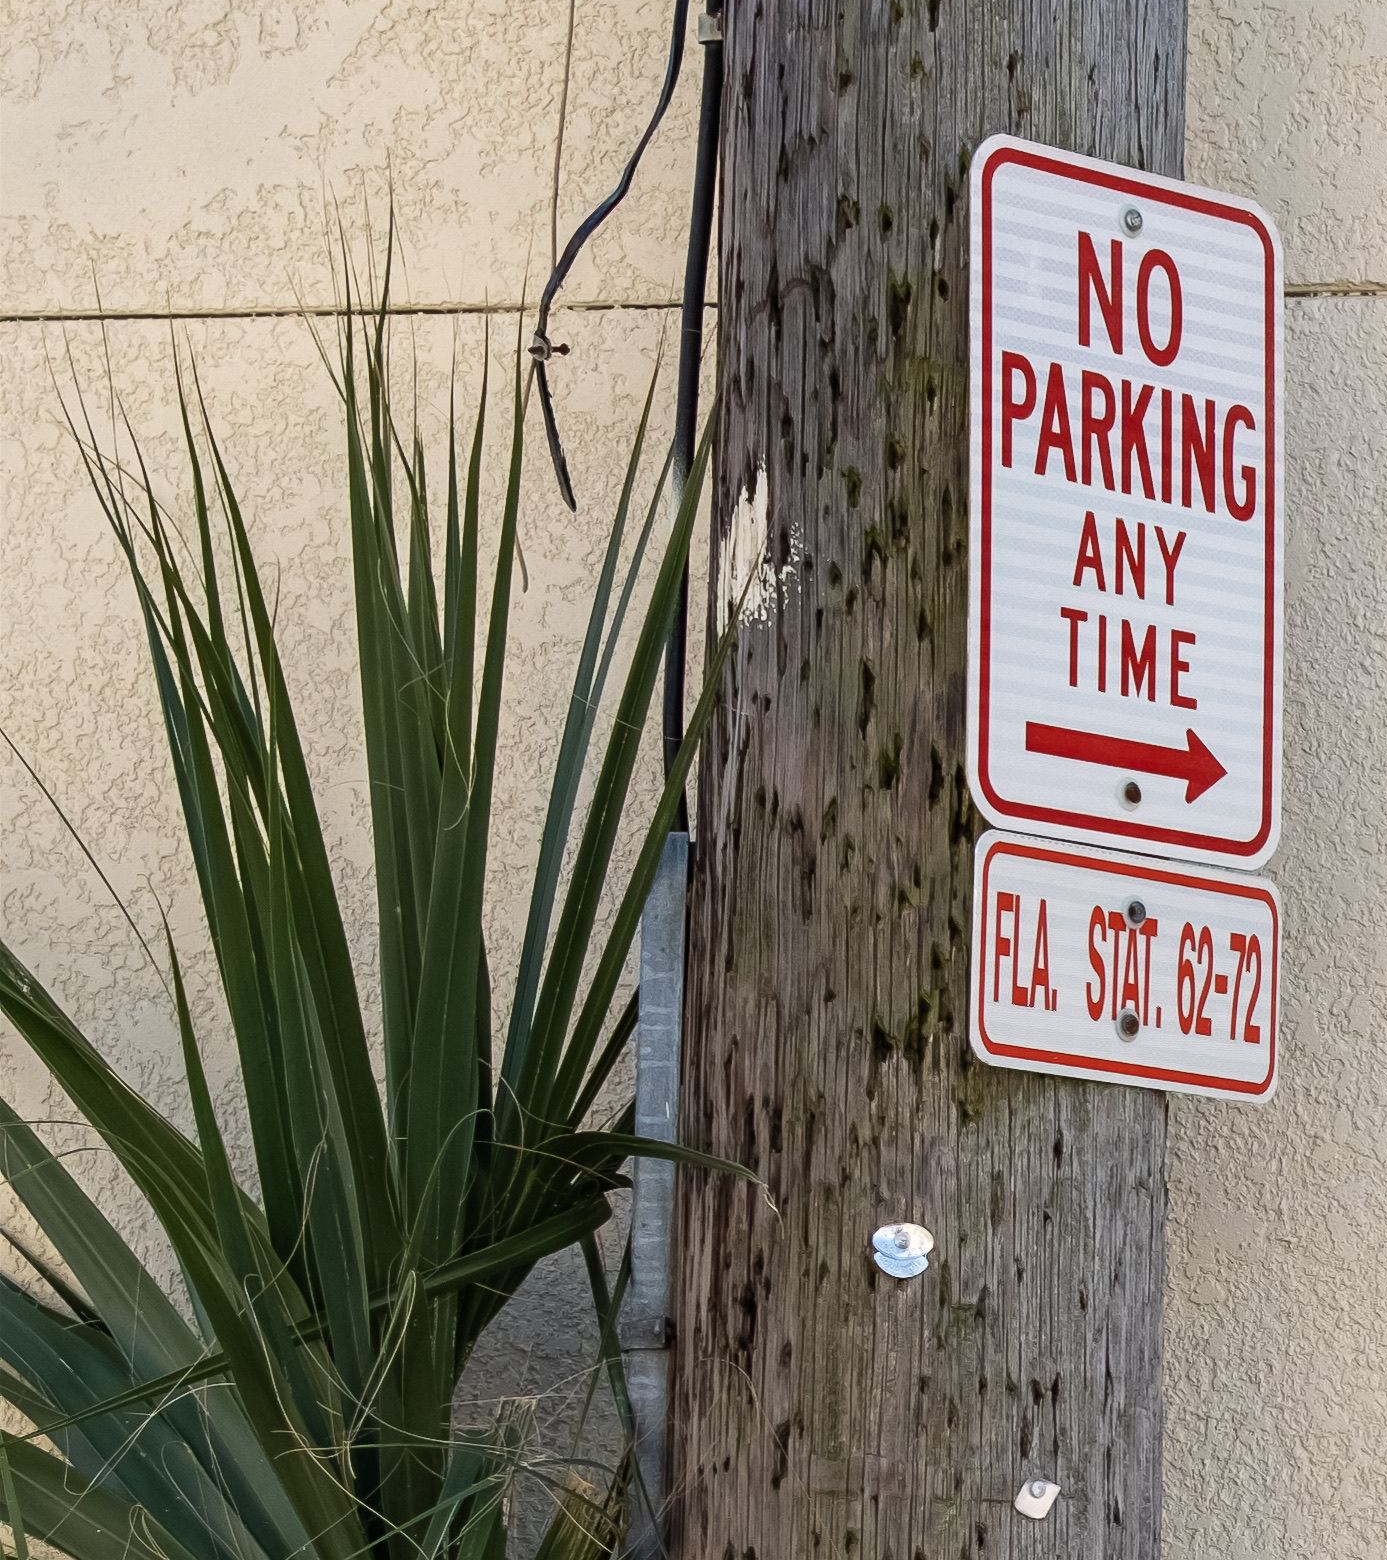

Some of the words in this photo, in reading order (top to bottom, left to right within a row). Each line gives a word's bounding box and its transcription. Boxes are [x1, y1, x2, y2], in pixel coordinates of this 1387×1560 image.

[1077, 230, 1184, 368] NO
[1001, 350, 1258, 522] PARKING
[1072, 510, 1187, 606] ANY
[1060, 606, 1198, 711] TIME
[993, 891, 1058, 1013] FLA.
[1086, 905, 1162, 1029] STAT.
[1177, 921, 1262, 1045] 62-72
